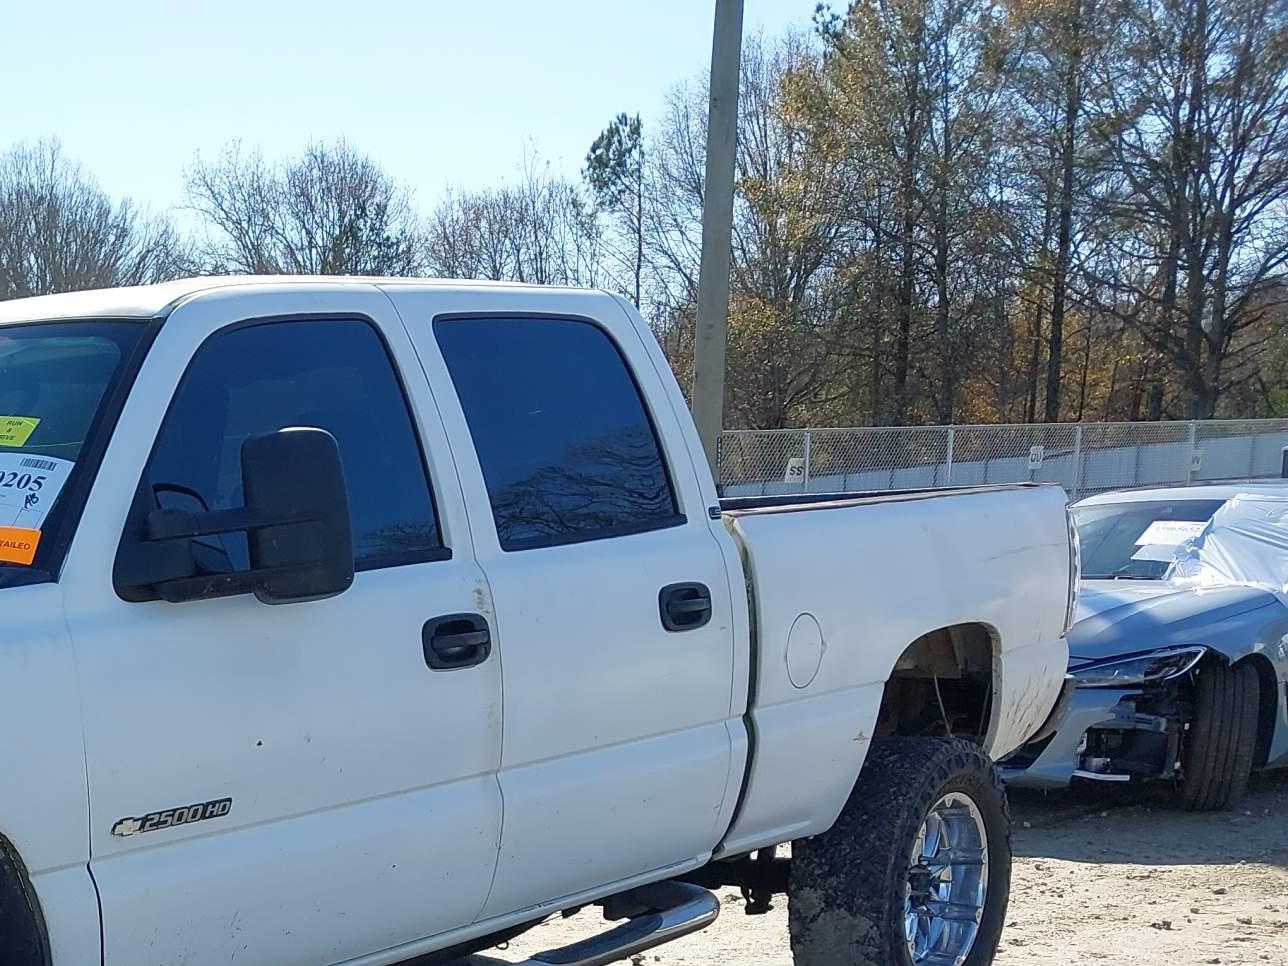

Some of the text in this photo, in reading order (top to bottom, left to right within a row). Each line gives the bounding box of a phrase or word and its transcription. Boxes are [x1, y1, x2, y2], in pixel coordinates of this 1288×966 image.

[789, 465, 804, 476] SS
[143, 800, 230, 831] 2500 HD
